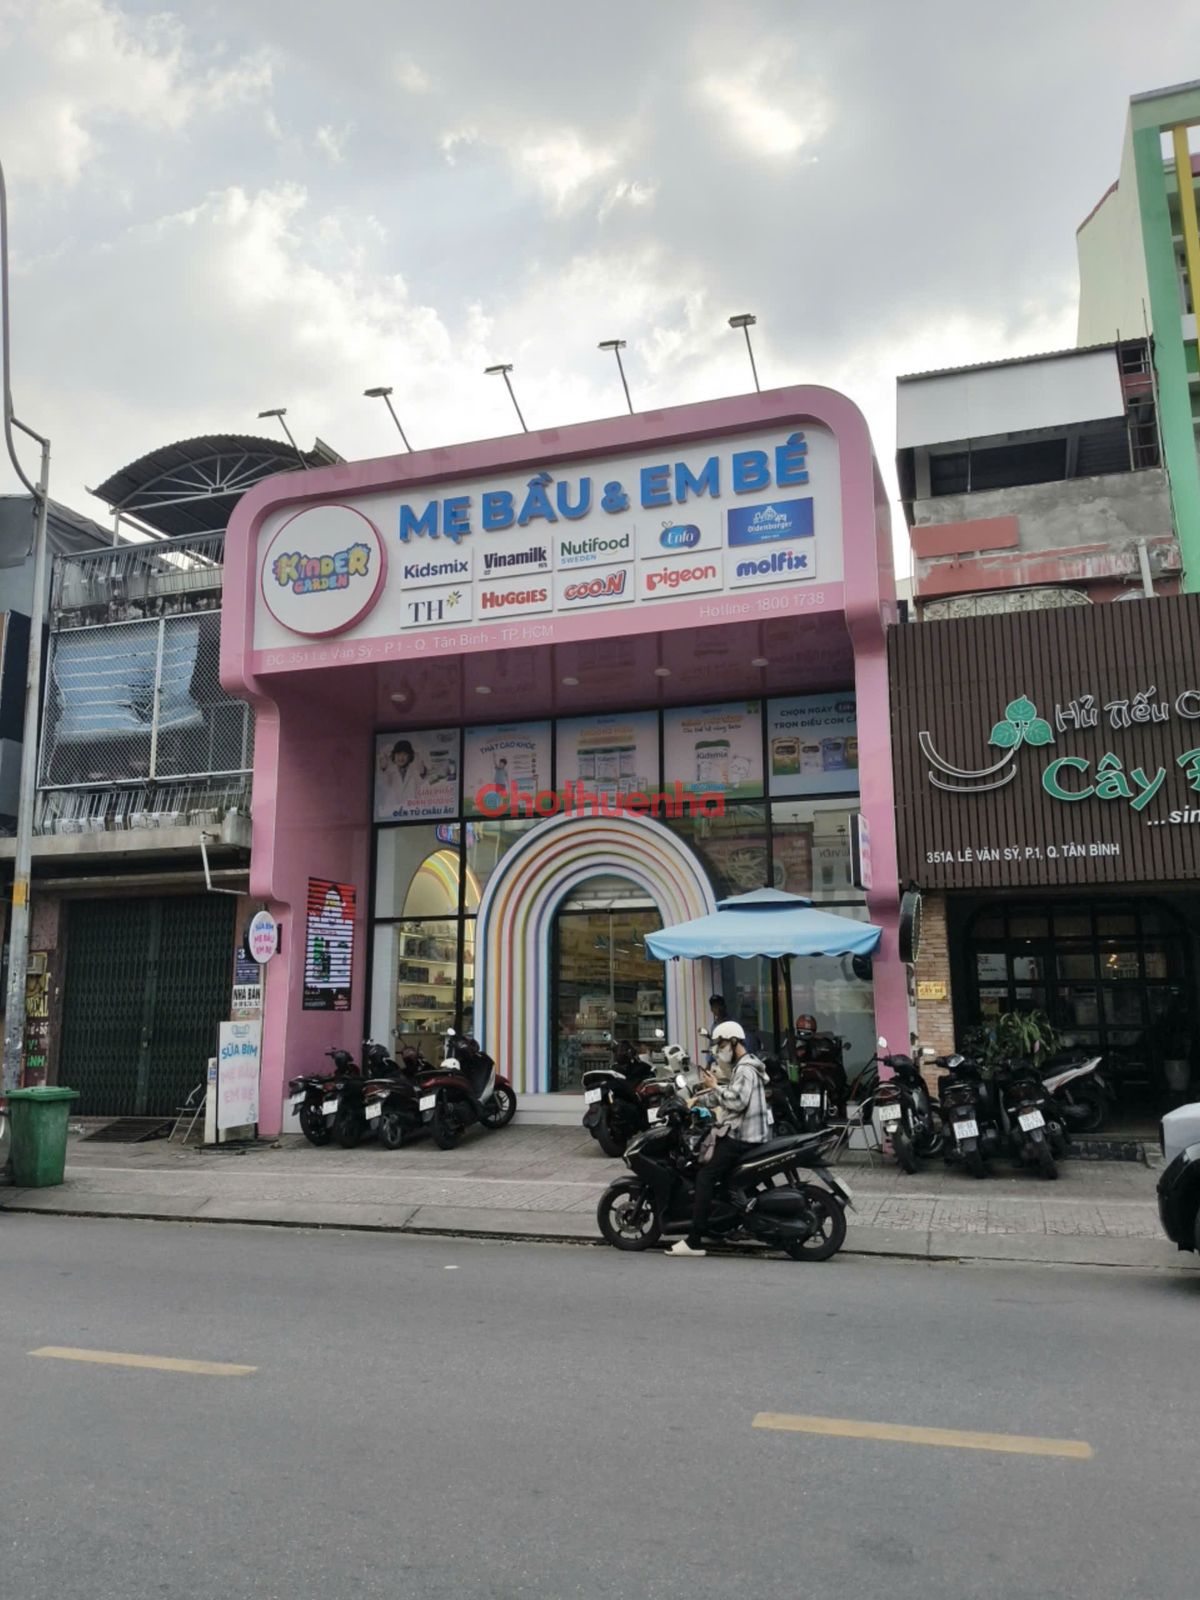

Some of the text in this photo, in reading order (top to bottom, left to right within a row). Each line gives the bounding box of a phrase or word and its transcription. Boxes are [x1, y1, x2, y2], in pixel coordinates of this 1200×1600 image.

[400, 432, 809, 544] MẸ BẦU & EM BÉ
[560, 533, 630, 556] Nutifood
[404, 559, 469, 579] Kidsmix
[484, 546, 547, 569] Vinamilk
[560, 554, 597, 564] SWEDEN
[736, 551, 808, 577] molfix
[408, 600, 444, 623] TH
[756, 596, 789, 611] 1800
[794, 592, 825, 607] 1738
[1055, 694, 1098, 733] Hủ
[1042, 751, 1166, 811] Cây
[927, 851, 954, 864] 351A
[957, 847, 973, 862] LÊ
[976, 846, 1000, 862] VĂN
[1047, 846, 1060, 858] Q.
[1061, 842, 1086, 857] TÂN
[1089, 840, 1120, 856] BÌNH
